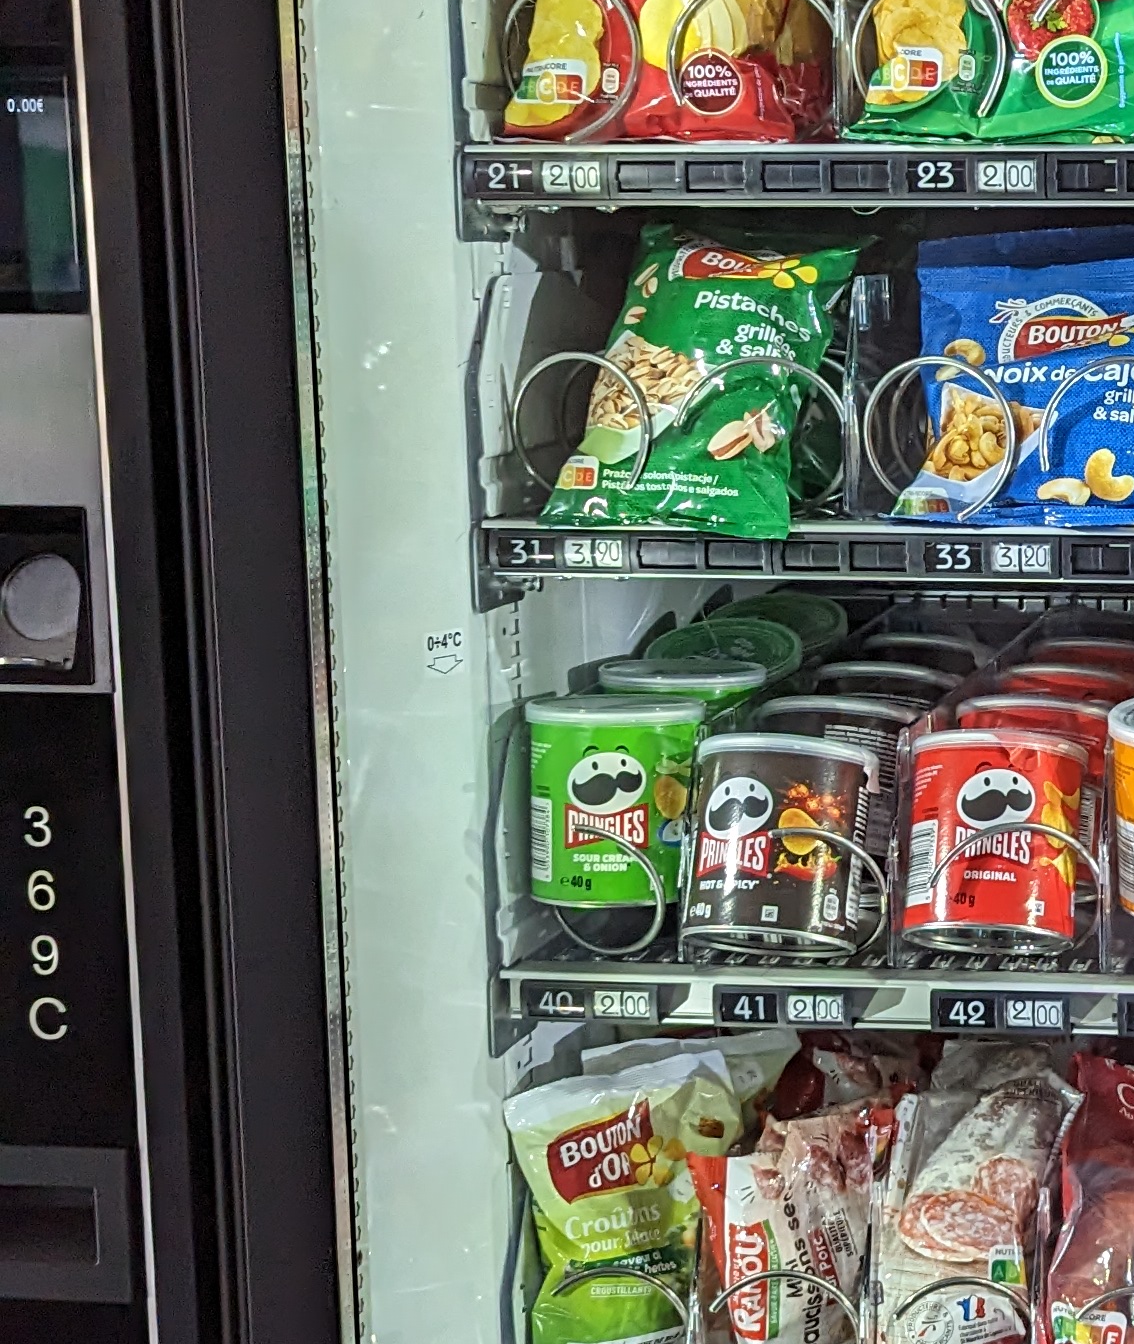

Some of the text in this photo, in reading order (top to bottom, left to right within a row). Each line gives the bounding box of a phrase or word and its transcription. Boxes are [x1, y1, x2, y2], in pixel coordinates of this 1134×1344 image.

[1049, 51, 1096, 66] 100%
[687, 64, 732, 80] 100%
[488, 164, 519, 189] 21
[917, 163, 954, 188] 23
[694, 290, 812, 343] Pistaches
[1028, 321, 1118, 346] BOUTON
[510, 539, 541, 563] 31
[935, 545, 971, 570] 33
[24, 806, 51, 847] 3
[568, 808, 645, 845] PRINGLES
[963, 870, 1016, 882] ORIGINAL
[28, 870, 56, 911] 6
[31, 935, 59, 975] 9
[538, 991, 573, 1014] 40
[733, 995, 766, 1019] 41
[949, 1001, 986, 1024] 42
[29, 997, 67, 1040] C
[560, 1114, 642, 1169] BOUTON
[732, 1227, 766, 1333] RANOU
